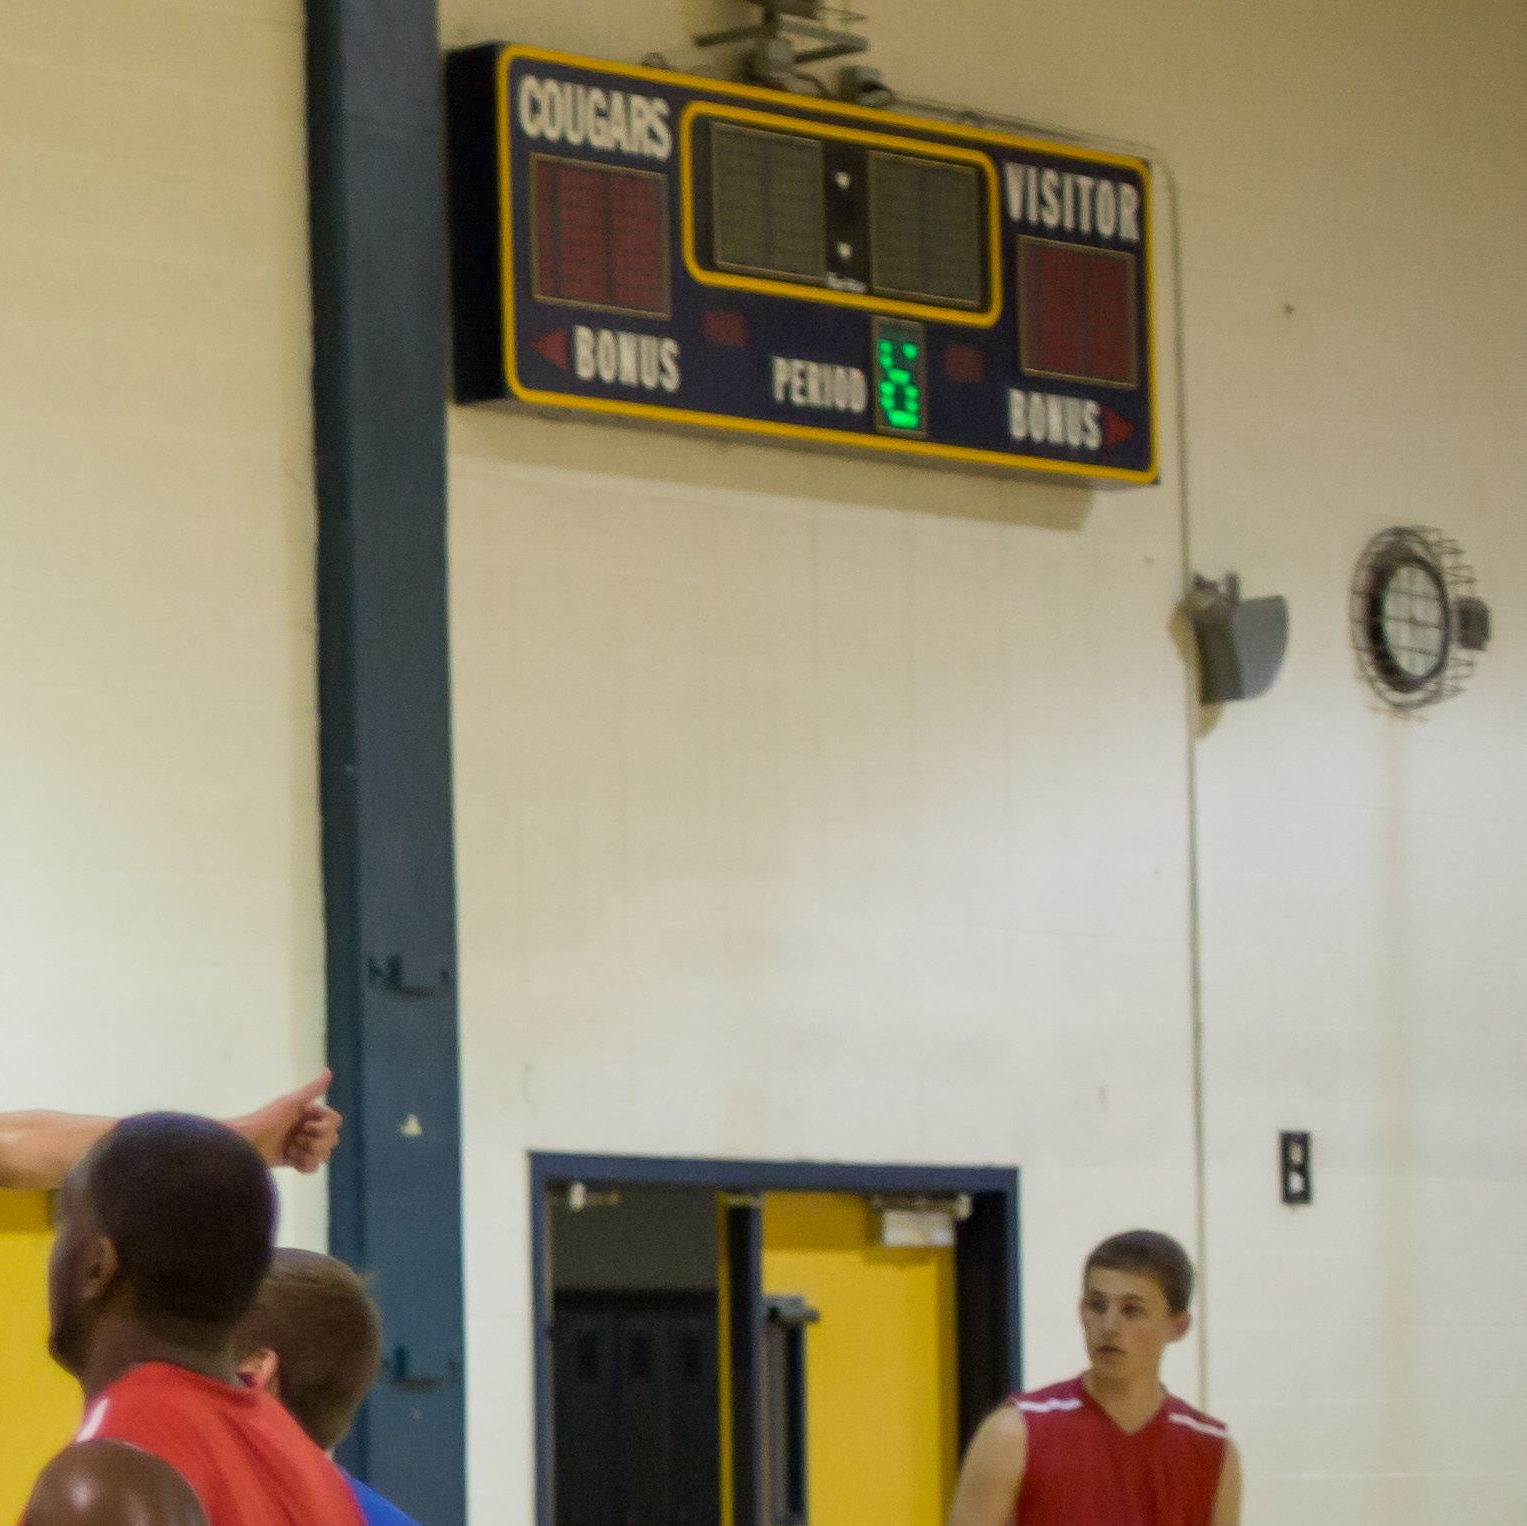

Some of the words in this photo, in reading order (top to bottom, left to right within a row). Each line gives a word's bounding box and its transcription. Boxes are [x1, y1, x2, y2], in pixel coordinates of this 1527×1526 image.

[519, 73, 672, 162] COUGARS
[1004, 161, 1141, 242] VISITOR
[573, 324, 681, 393] BONUS
[772, 355, 867, 414] PERIOD
[1009, 388, 1102, 450] BONUS
